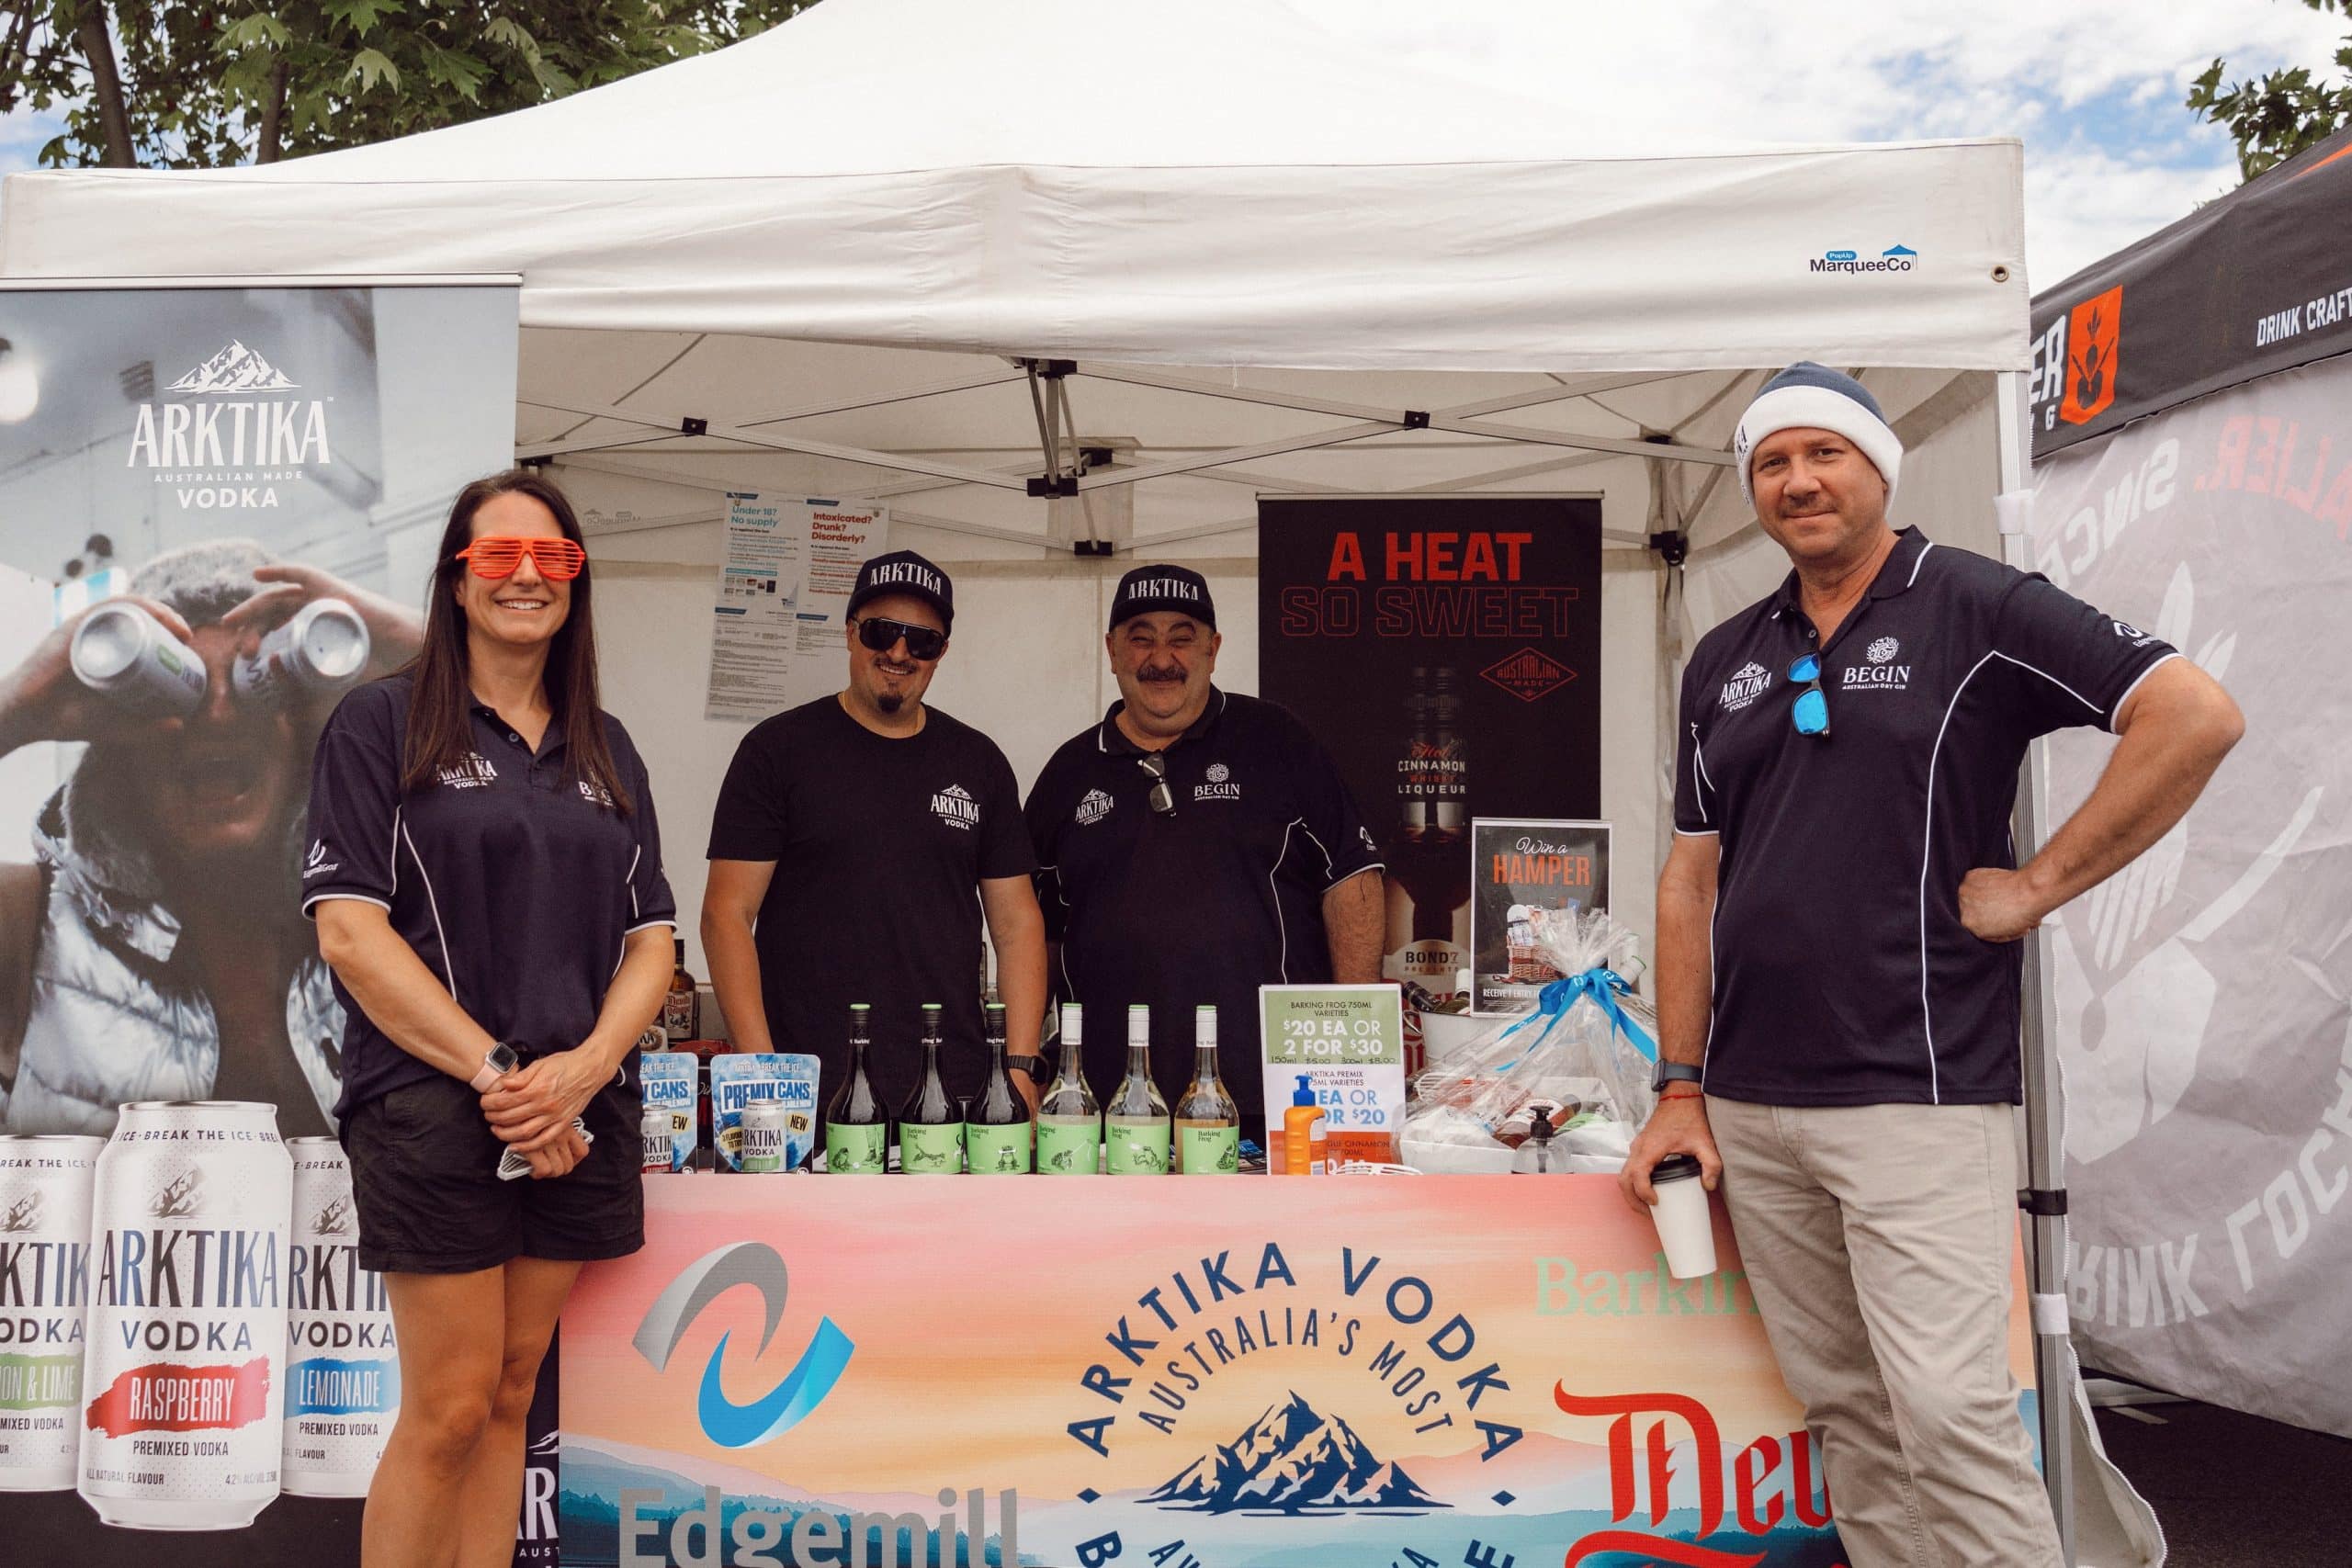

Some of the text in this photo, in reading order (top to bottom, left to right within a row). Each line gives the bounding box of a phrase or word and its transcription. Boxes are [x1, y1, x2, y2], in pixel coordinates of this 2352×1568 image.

[1810, 257, 1911, 275] MarqueeCo
[2256, 305, 2301, 347] DRINK
[127, 400, 332, 468] ARKTIKA
[153, 470, 303, 483] AUSTRALIAN MADE
[177, 487, 279, 509] VODKA
[732, 505, 762, 515] Under
[813, 512, 873, 525] Intoxicated?
[730, 515, 780, 528] No supply
[812, 522, 847, 532] Drunk?
[811, 532, 866, 545] Disorderly?
[1327, 532, 1532, 581] A HEAT
[870, 562, 942, 596] ARKTIKA
[1128, 578, 1199, 601] ARKTIKA
[1281, 586, 1579, 637] SO SWEET
[1497, 654, 1560, 680] AUSTRALIAN
[1842, 665, 1911, 683] BEGIN
[1718, 671, 1771, 705] ARKTIKA
[1397, 760, 1466, 773] CINNAMON
[1193, 784, 1240, 797] BEGIN
[1397, 784, 1466, 795] LIQUEUR
[931, 794, 979, 823] ARKTIKA
[1075, 795, 1114, 822] ARKTIKA
[944, 818, 970, 830] VODKA
[1516, 837, 1569, 854] Win a
[1493, 853, 1591, 886] HAMPER
[1406, 951, 1459, 964] BOND7
[1483, 988, 1505, 998] RECEIVE
[1283, 1020, 1382, 1036] $20 EA OR
[1284, 1039, 1383, 1055] 2 FOR $30
[651, 1081, 688, 1100] CANS
[777, 1081, 811, 1100] CANS
[1319, 1089, 1377, 1105] EA OR
[790, 1114, 808, 1132] NEW
[1352, 1109, 1385, 1125] $20
[144, 1130, 189, 1140] BREAK
[198, 1130, 225, 1140] THE
[232, 1131, 252, 1141] ICE
[745, 1148, 775, 1156] VODKA
[39, 1159, 62, 1168] THE
[67, 1159, 87, 1168] ICE
[305, 1161, 344, 1169] BREAK
[97, 1229, 279, 1308] ARKTIKA
[121, 1320, 252, 1351] VODKA
[289, 1321, 395, 1348] VODKA
[1067, 1242, 1524, 1462] ARKTIKA VODKA
[1137, 1307, 1453, 1435] AUSTRALIA'S MOST
[27, 1366, 38, 1402] &
[41, 1364, 75, 1402] LIME
[299, 1369, 381, 1407] LEMONADE
[130, 1377, 235, 1422] RASPBERRY
[1, 1417, 64, 1430] MIXED VODKA
[300, 1422, 379, 1436] PREMIXED VODKA
[133, 1440, 229, 1456] PREMIXED VODKA
[295, 1448, 325, 1459] FLAVOUR
[128, 1472, 164, 1484] FLAVOUR
[618, 1484, 1019, 1568] Edgemill
